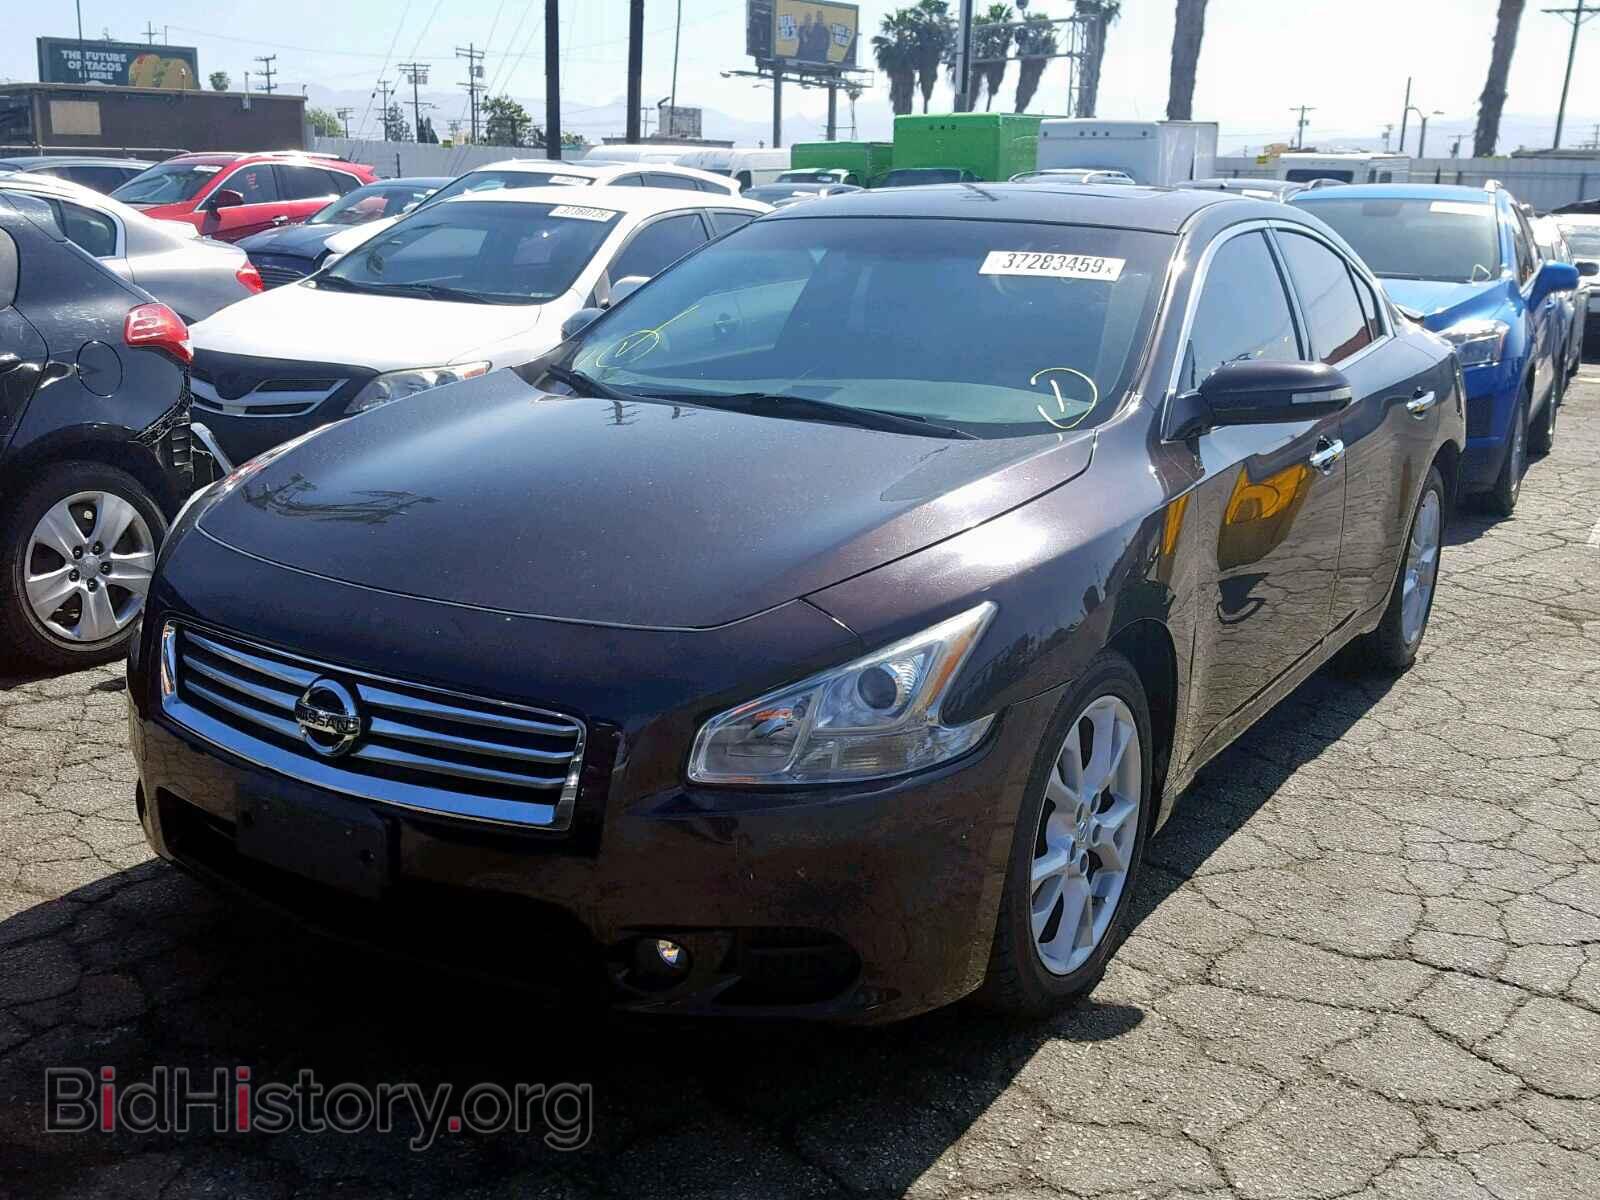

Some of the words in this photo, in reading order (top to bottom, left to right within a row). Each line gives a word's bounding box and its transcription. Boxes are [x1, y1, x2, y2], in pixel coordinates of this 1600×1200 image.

[61, 50, 81, 60] THE
[85, 51, 127, 63] FUTURE
[67, 60, 81, 70] OF
[84, 61, 122, 72] TACOS
[89, 71, 113, 80] HERE
[296, 709, 350, 732] NISSAN
